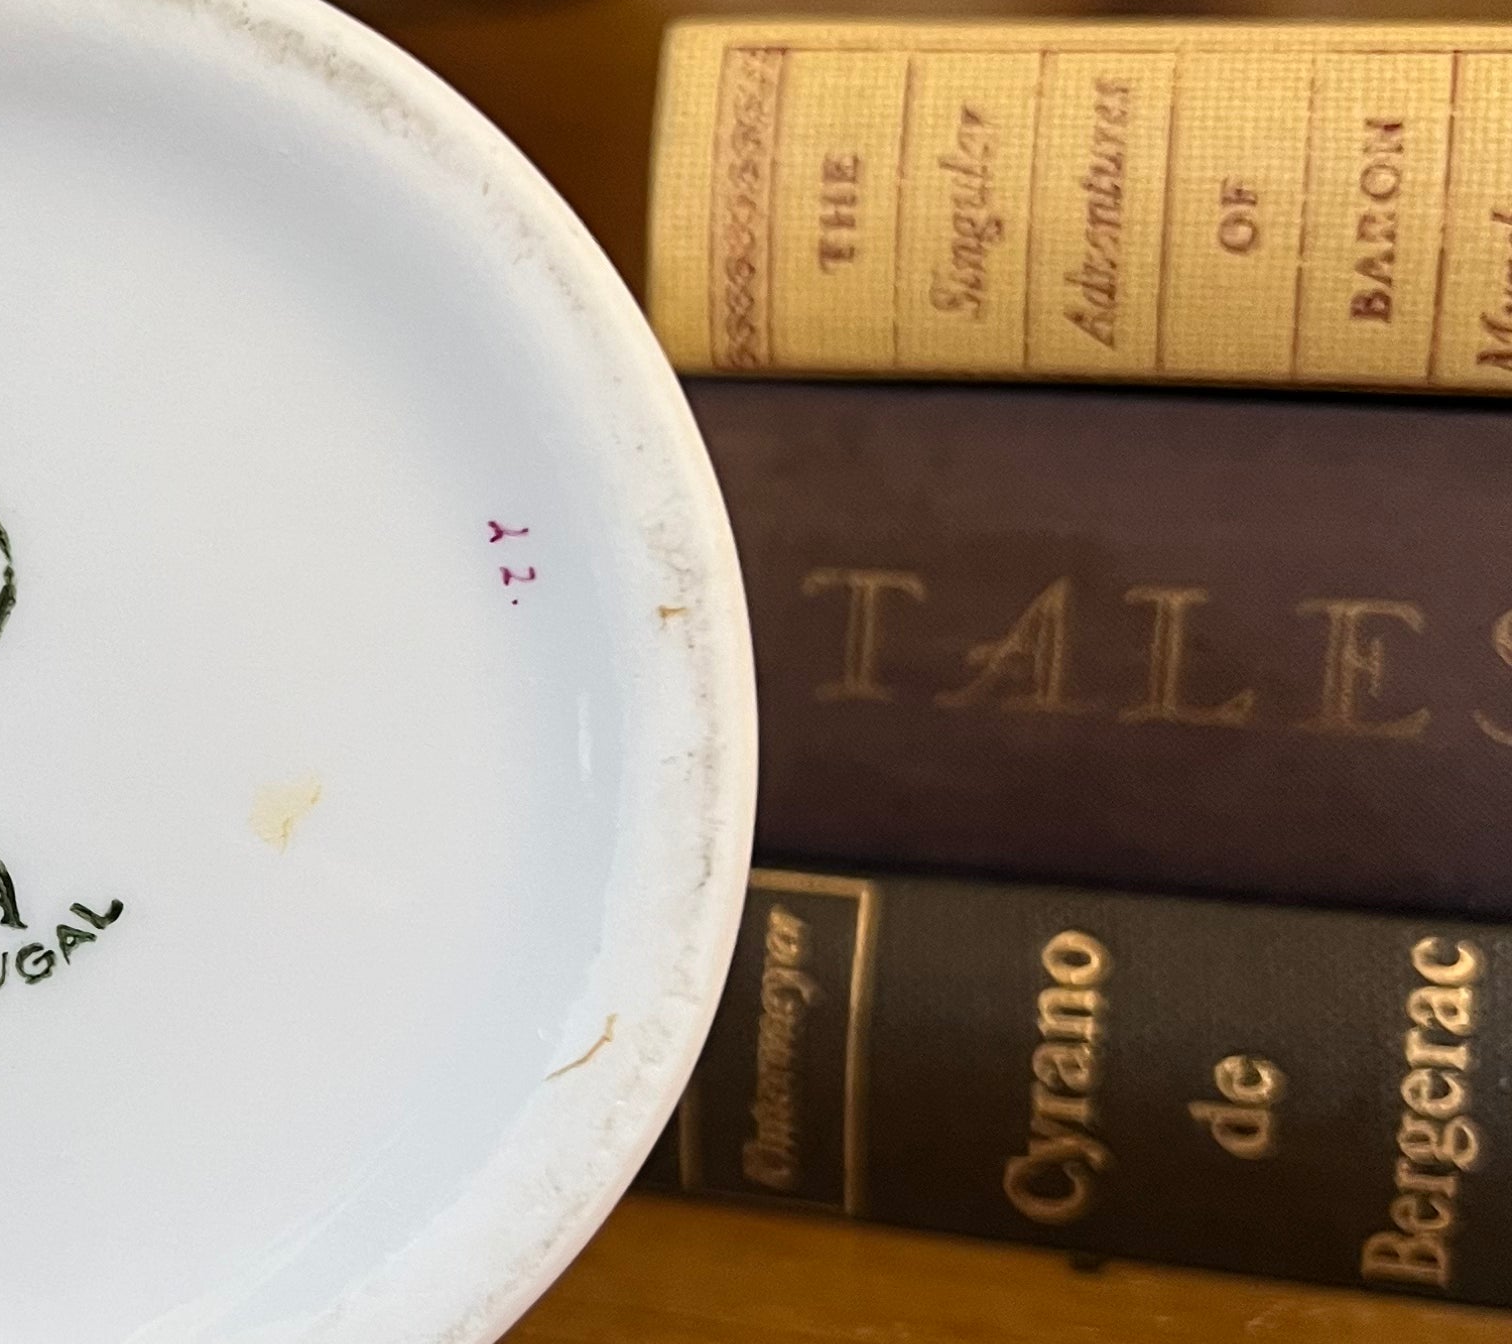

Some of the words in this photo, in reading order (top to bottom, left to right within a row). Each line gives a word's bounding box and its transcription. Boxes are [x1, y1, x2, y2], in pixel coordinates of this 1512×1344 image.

[818, 152, 861, 276] THE
[1064, 76, 1132, 350] Adventures
[1219, 175, 1260, 255] OF
[1351, 117, 1404, 324] BARON
[1003, 929, 1112, 1225] Cyrano
[1188, 1054, 1284, 1159] de
[1361, 935, 1486, 1290] Bergerac
